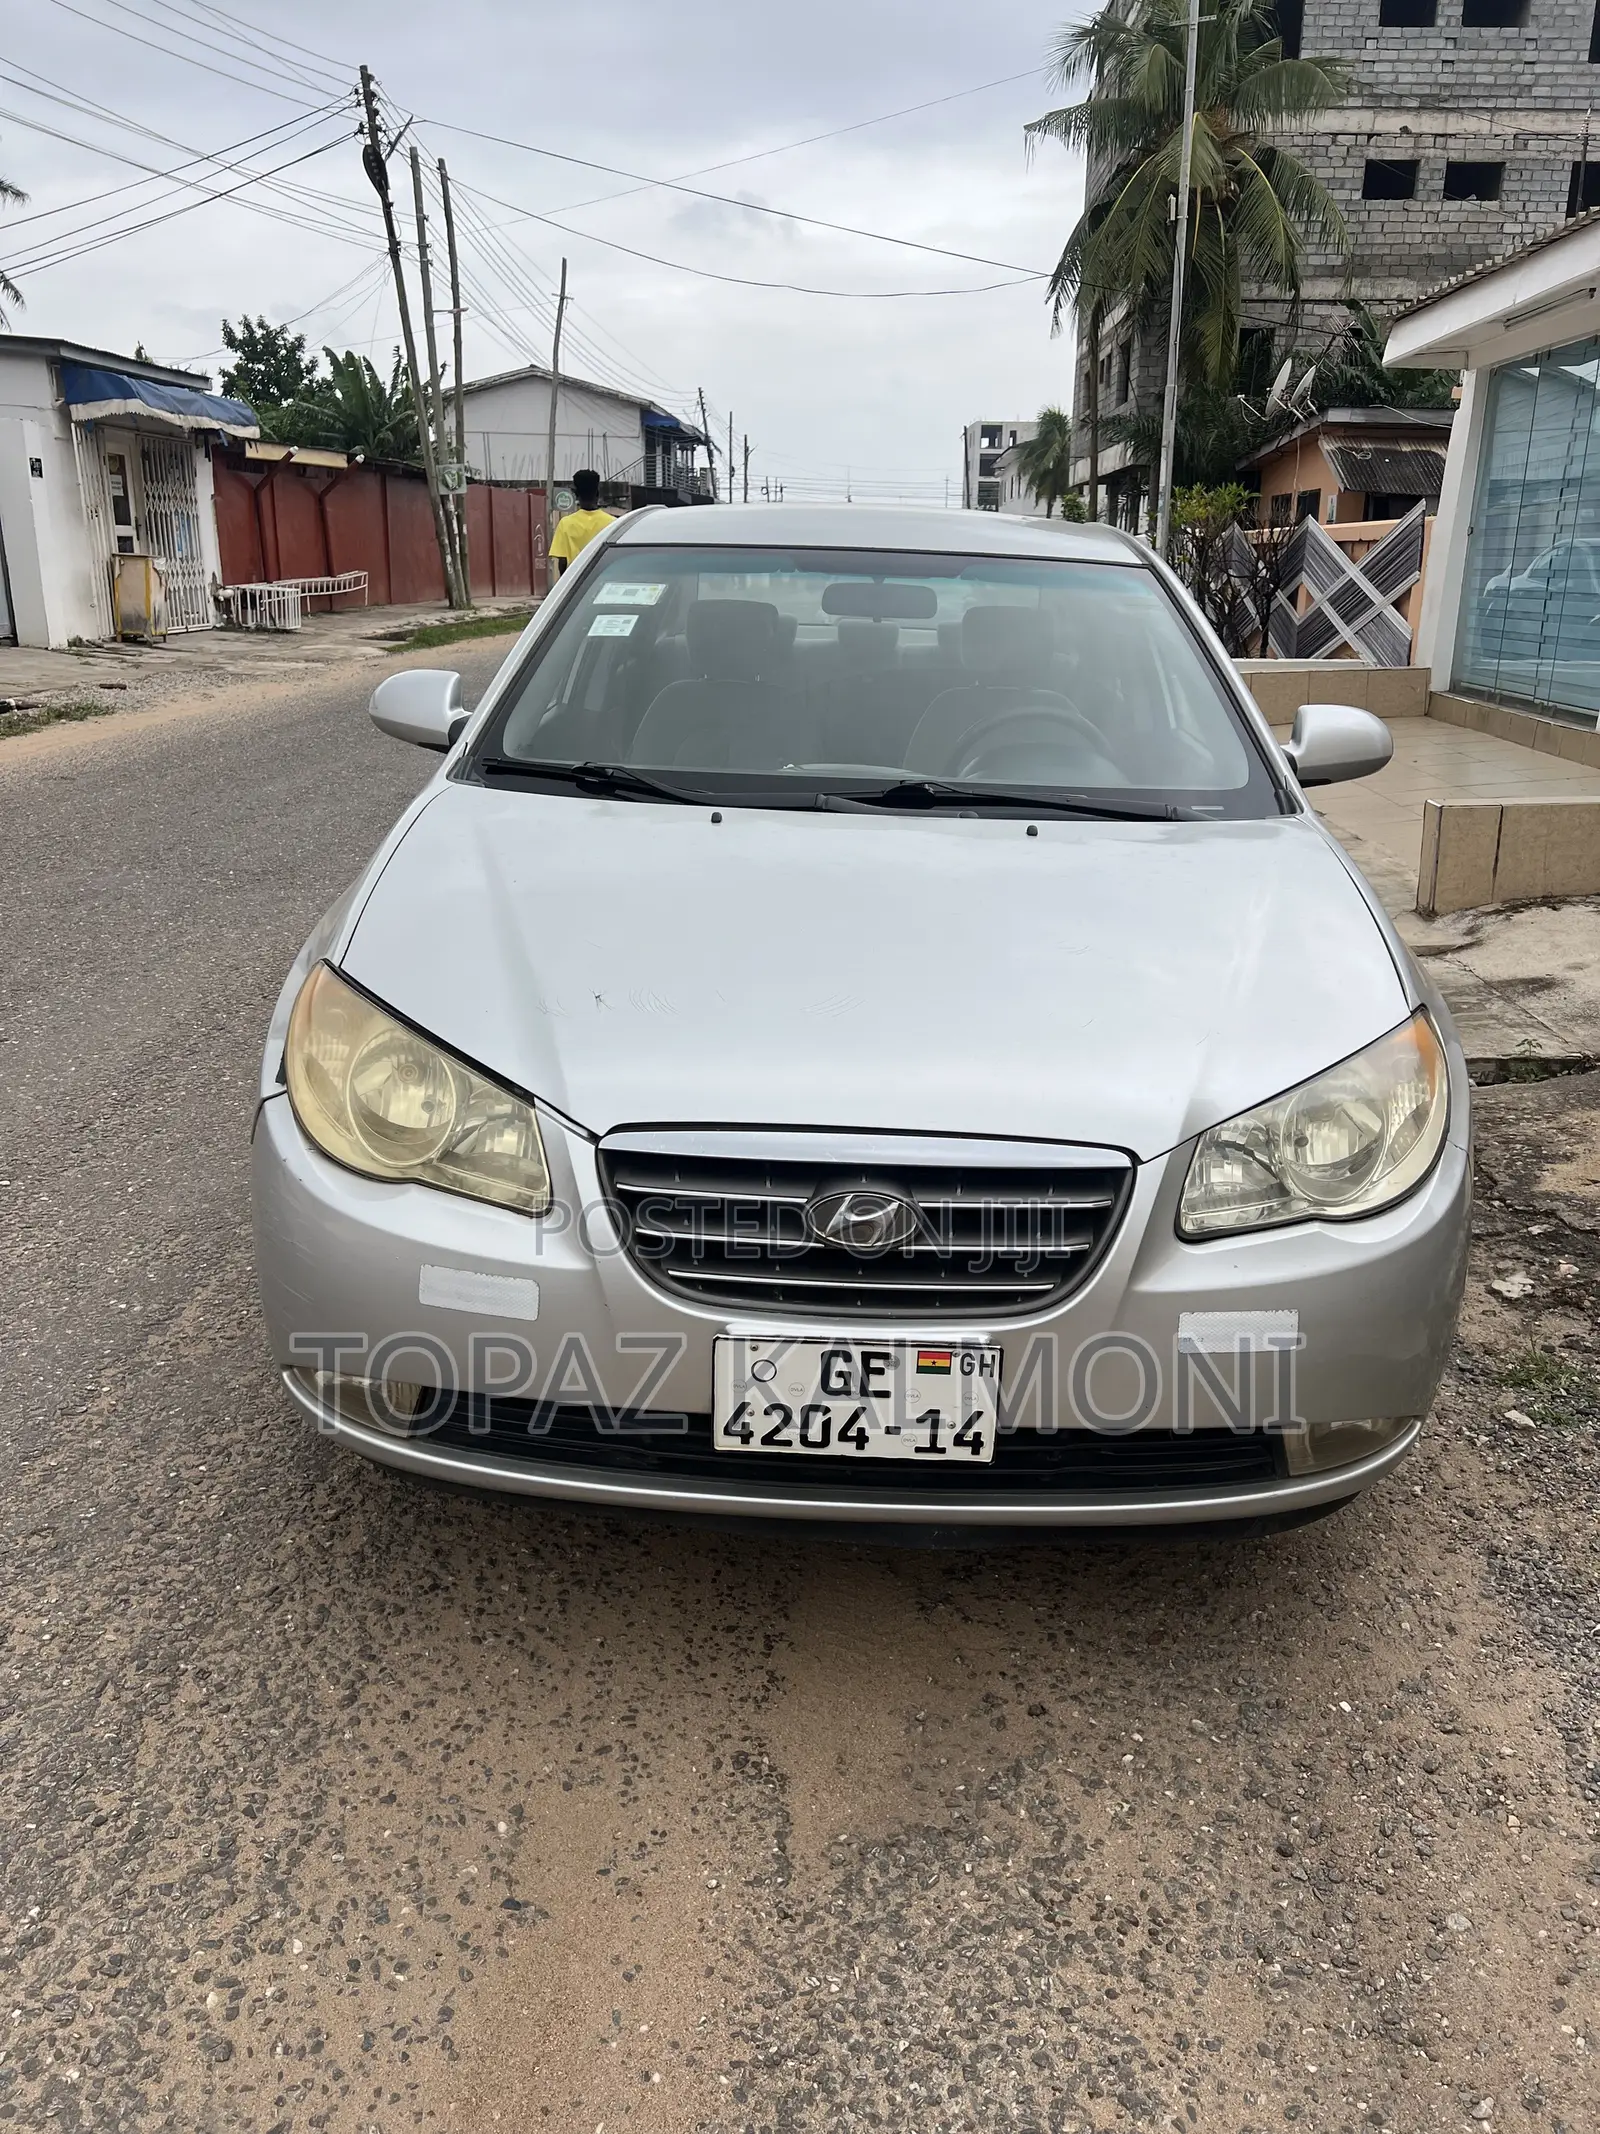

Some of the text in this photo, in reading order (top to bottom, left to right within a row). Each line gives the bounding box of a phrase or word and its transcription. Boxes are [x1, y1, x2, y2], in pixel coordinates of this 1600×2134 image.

[820, 1349, 892, 1398] GE
[959, 1352, 996, 1378] GH
[722, 1401, 986, 1456] 4204-14
